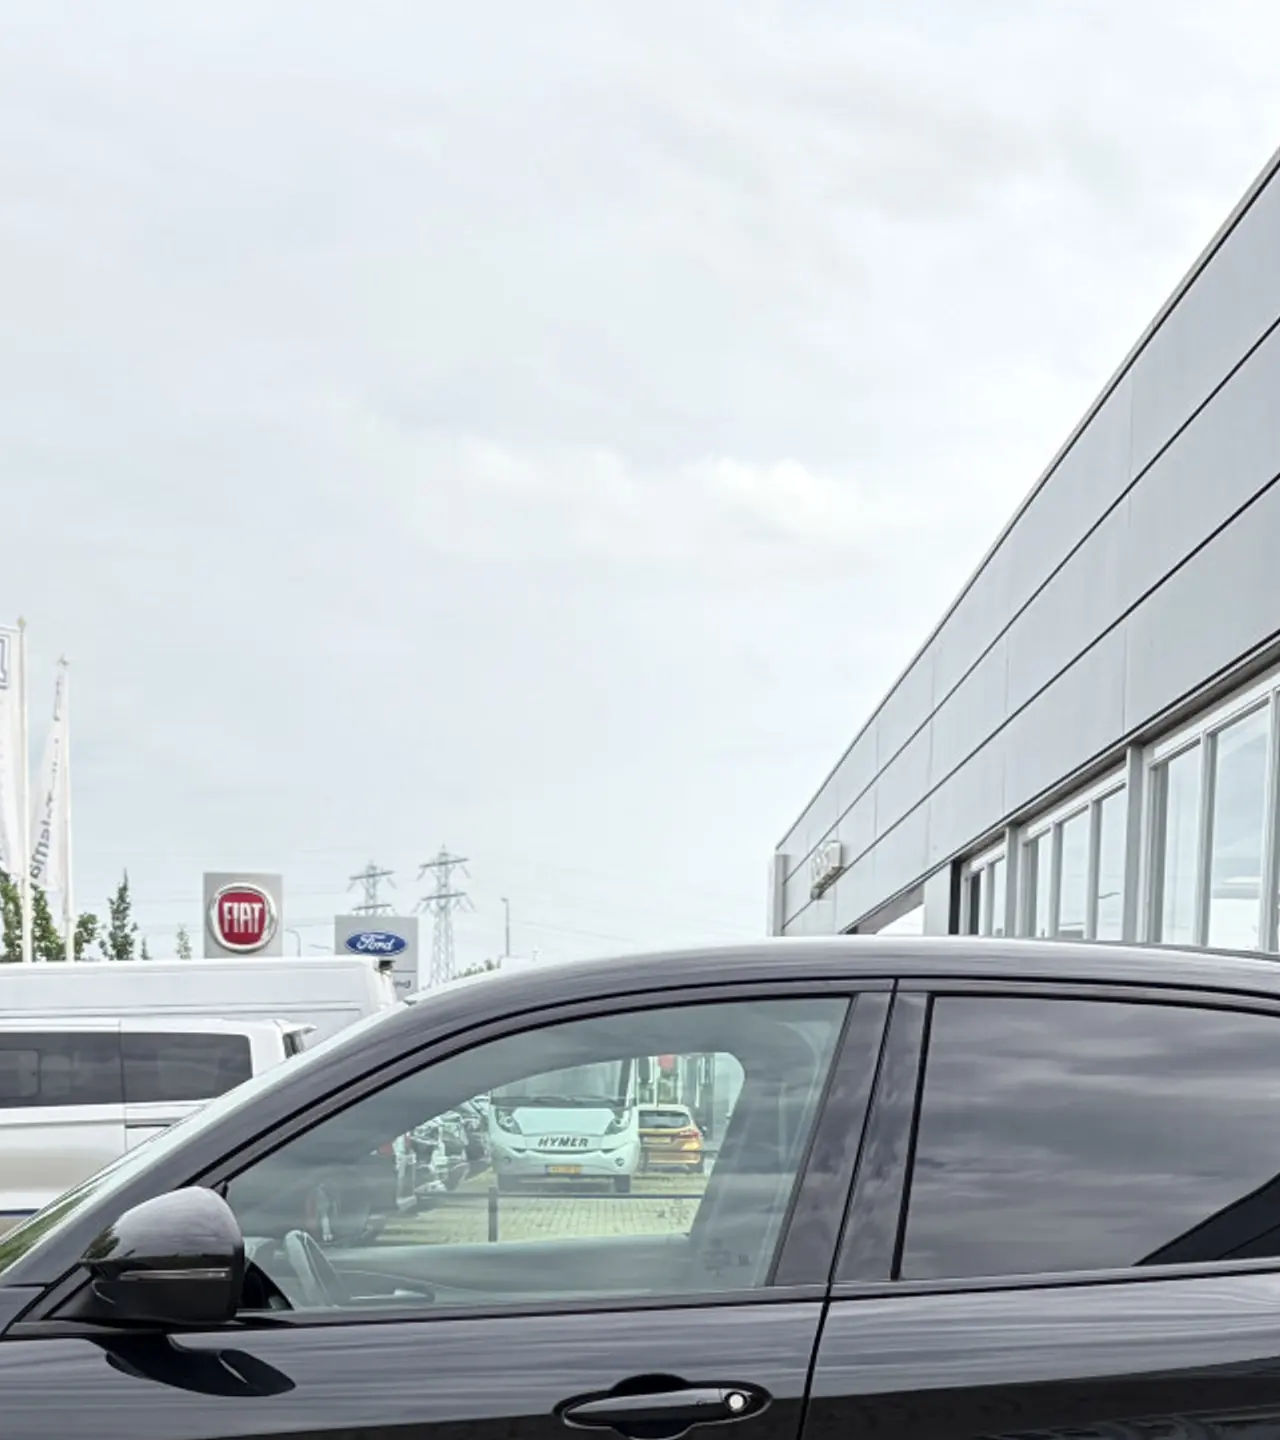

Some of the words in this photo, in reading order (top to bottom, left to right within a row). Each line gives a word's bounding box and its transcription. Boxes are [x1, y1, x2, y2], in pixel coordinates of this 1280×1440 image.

[223, 901, 263, 934] FIAT
[355, 931, 396, 951] Ford
[538, 1137, 589, 1148] HYMER
